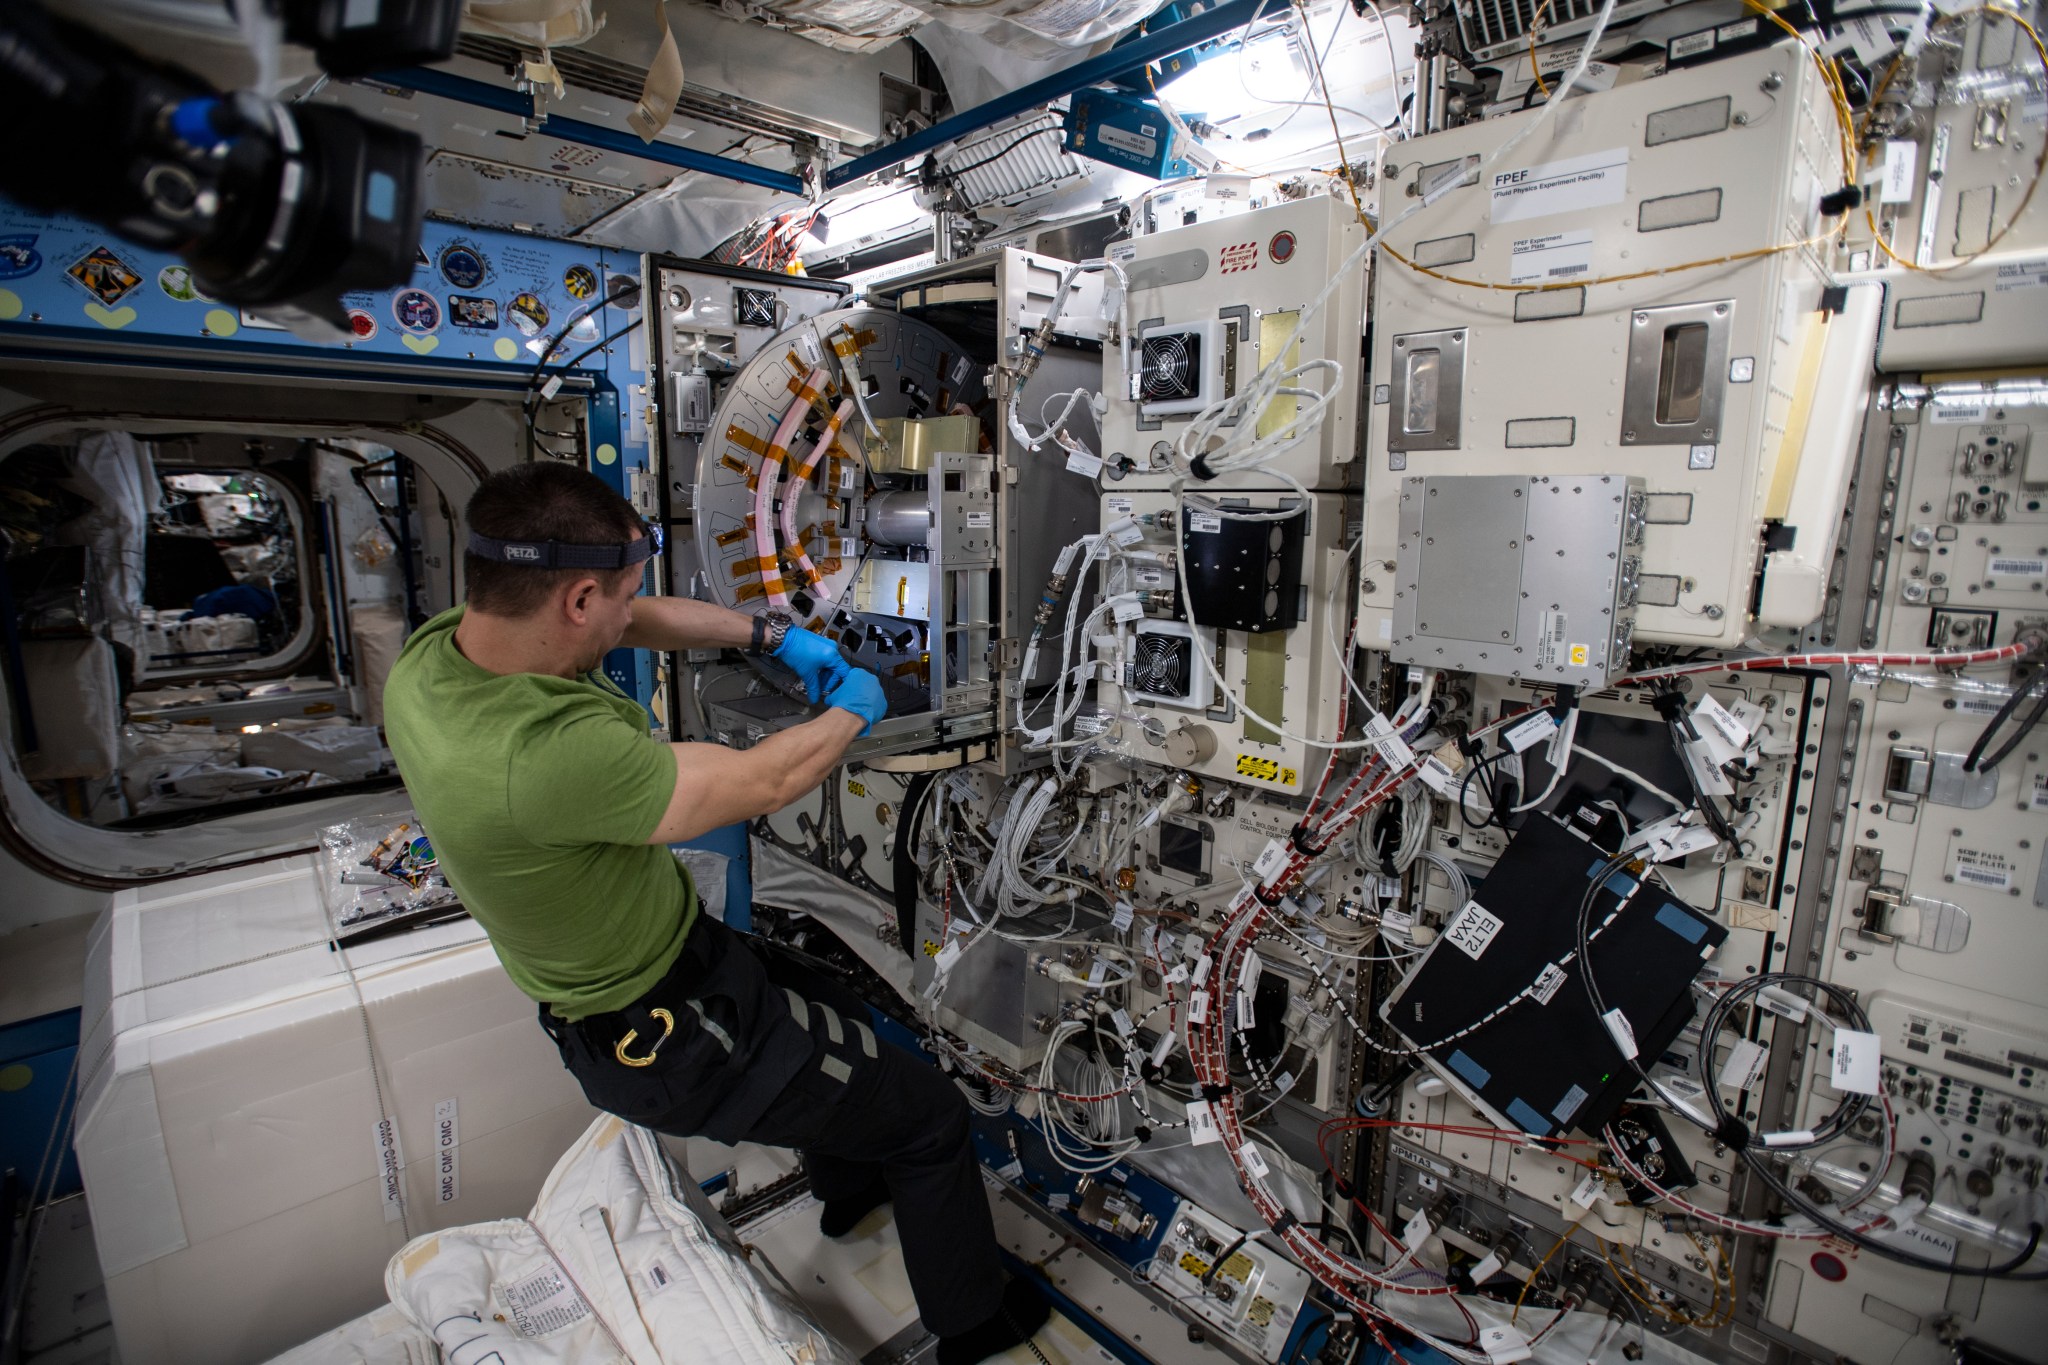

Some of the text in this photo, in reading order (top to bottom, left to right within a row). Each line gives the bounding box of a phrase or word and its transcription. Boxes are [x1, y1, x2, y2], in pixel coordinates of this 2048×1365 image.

[1494, 171, 1605, 199] (Fluid Physics Experiment Facility)
[1495, 169, 1529, 186] FPEF
[1530, 234, 1562, 245] Experiment
[1513, 245, 1529, 253] Cover
[1238, 254, 1252, 262] PORT
[885, 266, 905, 276] FREEZER
[505, 546, 541, 561] PETZL
[1239, 824, 1263, 835] CONTROL
[1240, 817, 1253, 826] CELL
[1255, 821, 1278, 832] BIOLOGY
[1981, 852, 2004, 861] PASS
[1980, 859, 2007, 870] PLATE
[1450, 906, 1480, 941] JAXA
[1465, 917, 1496, 952] ELT2
[441, 1120, 453, 1201] CMC CMC CMC
[1392, 1146, 1431, 1168] JPM1A3
[1920, 1233, 1953, 1252] (AAA)
